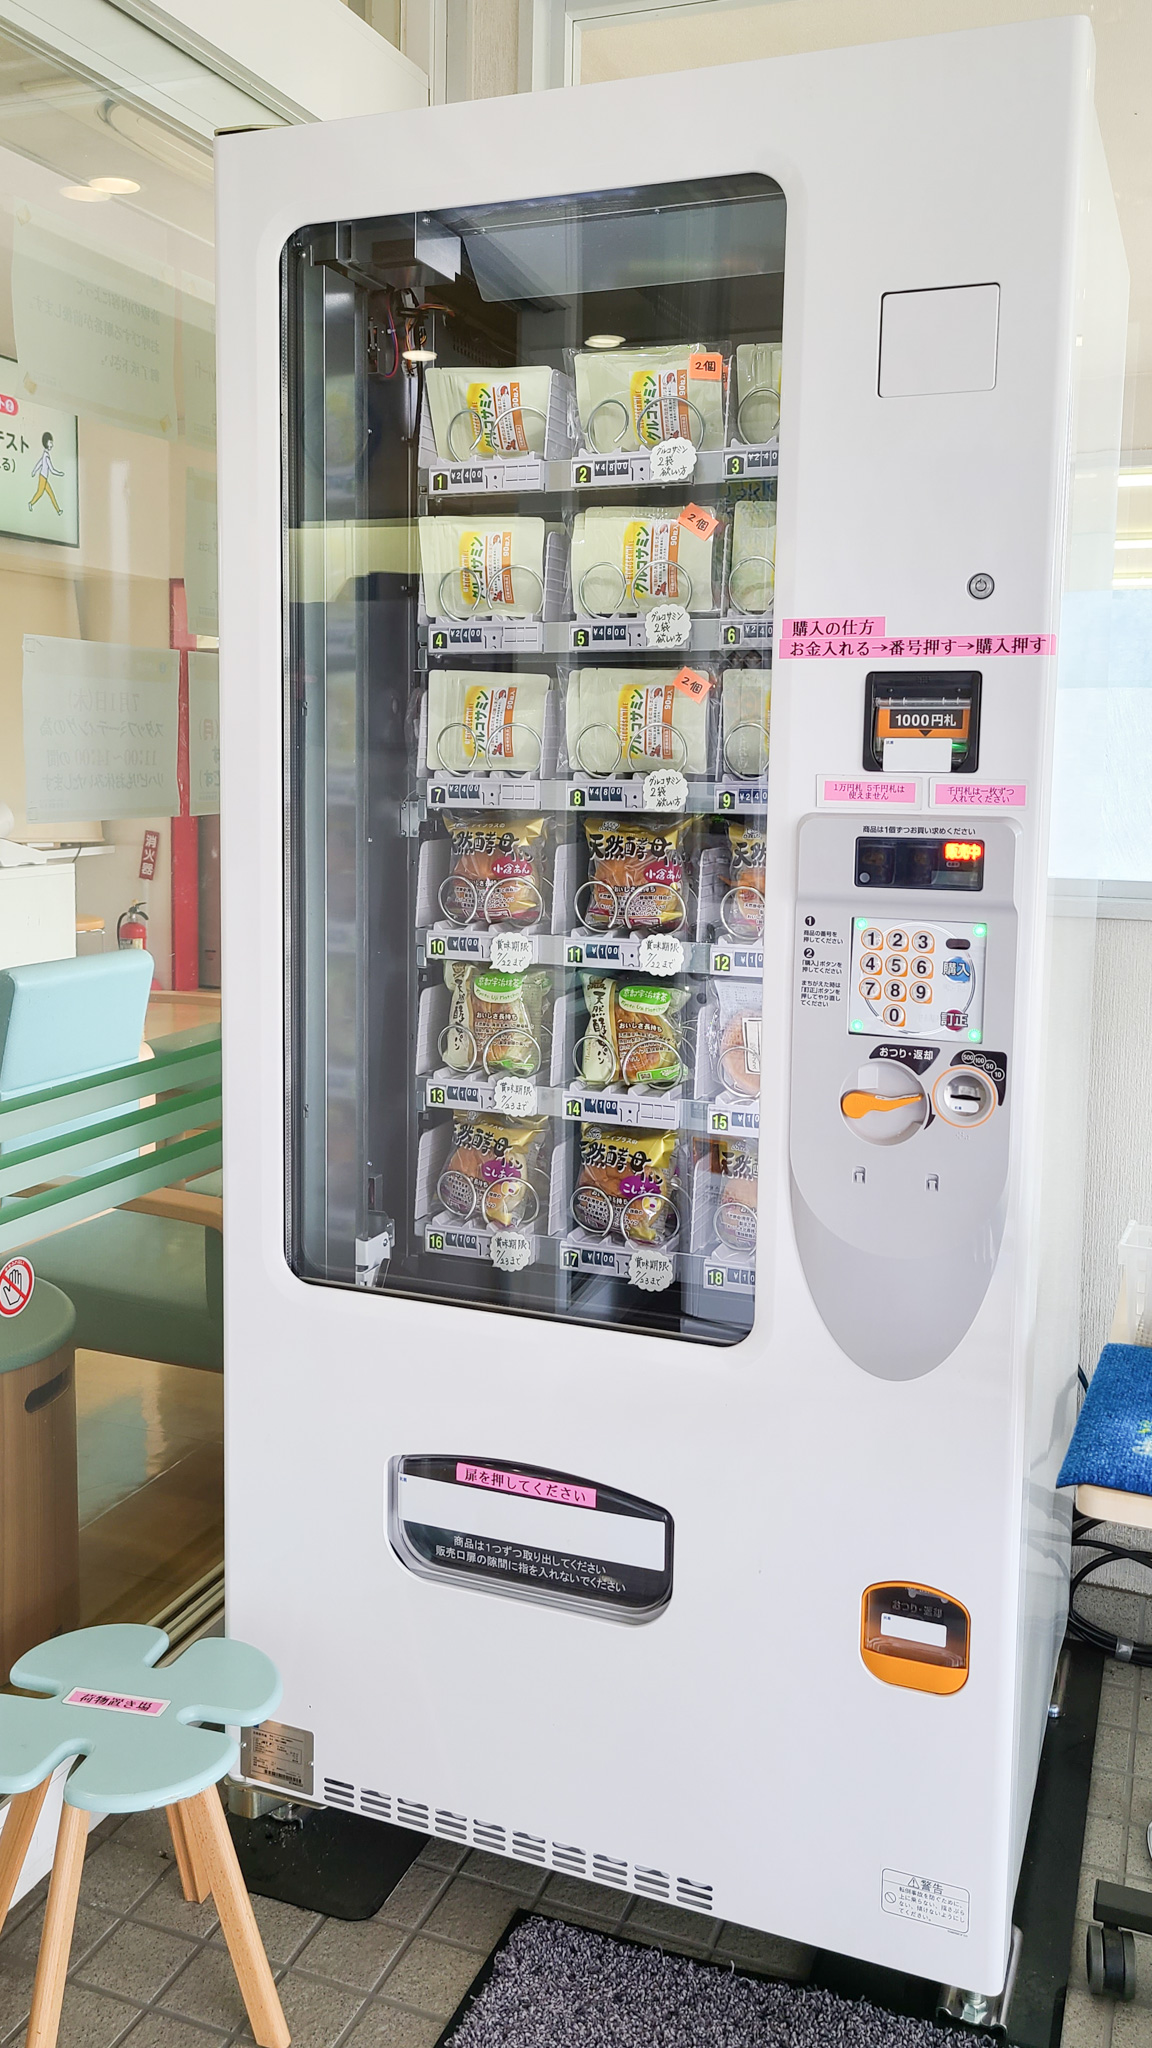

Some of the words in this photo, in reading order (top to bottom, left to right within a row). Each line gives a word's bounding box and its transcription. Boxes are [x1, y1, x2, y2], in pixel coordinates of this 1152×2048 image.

[695, 360, 716, 372] 2個
[656, 446, 689, 456] グルコサミン
[595, 461, 628, 472] ¥4800
[732, 458, 740, 473] 3
[451, 470, 482, 480] ¥2400
[579, 467, 587, 482] 2
[437, 475, 443, 489] 1
[687, 513, 709, 532] 2個
[650, 612, 684, 623] グルコサミン
[451, 630, 481, 638] ¥2400
[593, 627, 625, 637] ¥4800
[793, 619, 875, 637] 購入の仕方
[435, 634, 443, 647] 4
[577, 631, 585, 646] 5
[728, 628, 736, 643] 6
[681, 676, 703, 695] 2個
[895, 714, 957, 727] 1000円札
[649, 776, 682, 786] グルコサミン
[435, 788, 442, 802] 7
[449, 784, 479, 793] ¥2400
[589, 787, 621, 796] ¥4800
[834, 783, 863, 793] 1万円札
[866, 784, 905, 794] 5千円札は
[947, 787, 1015, 796] 千円札は一枚ずつ
[574, 791, 581, 805] 8
[723, 793, 731, 808] 9
[848, 791, 889, 801] 使えません
[951, 795, 1010, 804] 入れてください
[862, 825, 976, 835] 商品は1個ずつお買い求めください
[141, 834, 158, 876] 消火器
[493, 863, 530, 875] 小倉あん
[645, 869, 682, 881] 小倉あん
[803, 930, 838, 938] 商品の番号を
[803, 937, 844, 945] 押してください
[868, 932, 875, 946] 1
[892, 933, 903, 947] 2
[918, 935, 928, 949] 3
[431, 940, 445, 954] 10
[496, 939, 530, 953] 賞味期限
[646, 940, 680, 954] 賞味期限
[568, 948, 581, 962] 11
[714, 955, 730, 970] 12
[865, 957, 876, 971] 4
[891, 958, 901, 973] 5
[916, 960, 927, 975] 6
[942, 961, 971, 977] 購入
[802, 967, 842, 975] 押してください
[801, 980, 841, 988] まちがえた時は
[865, 982, 876, 996] 7
[890, 983, 900, 998] 8
[916, 985, 926, 1000] 9
[801, 994, 841, 1002] 押してやり直し
[476, 1011, 519, 1021] おいしさ長持ち
[889, 1008, 899, 1022] 0
[940, 1011, 969, 1028] 訂正
[619, 1022, 663, 1033] おいしさ長持ち
[879, 1047, 934, 1061] おつり・返却
[431, 1089, 444, 1103] 13
[500, 1082, 533, 1096] 賞味期限
[567, 1102, 580, 1116] 14
[712, 1115, 728, 1130] 15
[429, 1234, 443, 1249] 16
[495, 1238, 528, 1250] 賞味期限
[564, 1252, 578, 1265] 17
[635, 1256, 669, 1272] 賞味期限
[708, 1271, 723, 1286] 18
[465, 1467, 587, 1503] 扉を押してください
[453, 1535, 607, 1575] 商品は1つずつ取り出してください
[435, 1544, 627, 1593] 販売口扉の隙間に指を入れないでください
[80, 1693, 152, 1712] 荷物置き場
[921, 1879, 944, 1895] 警告
